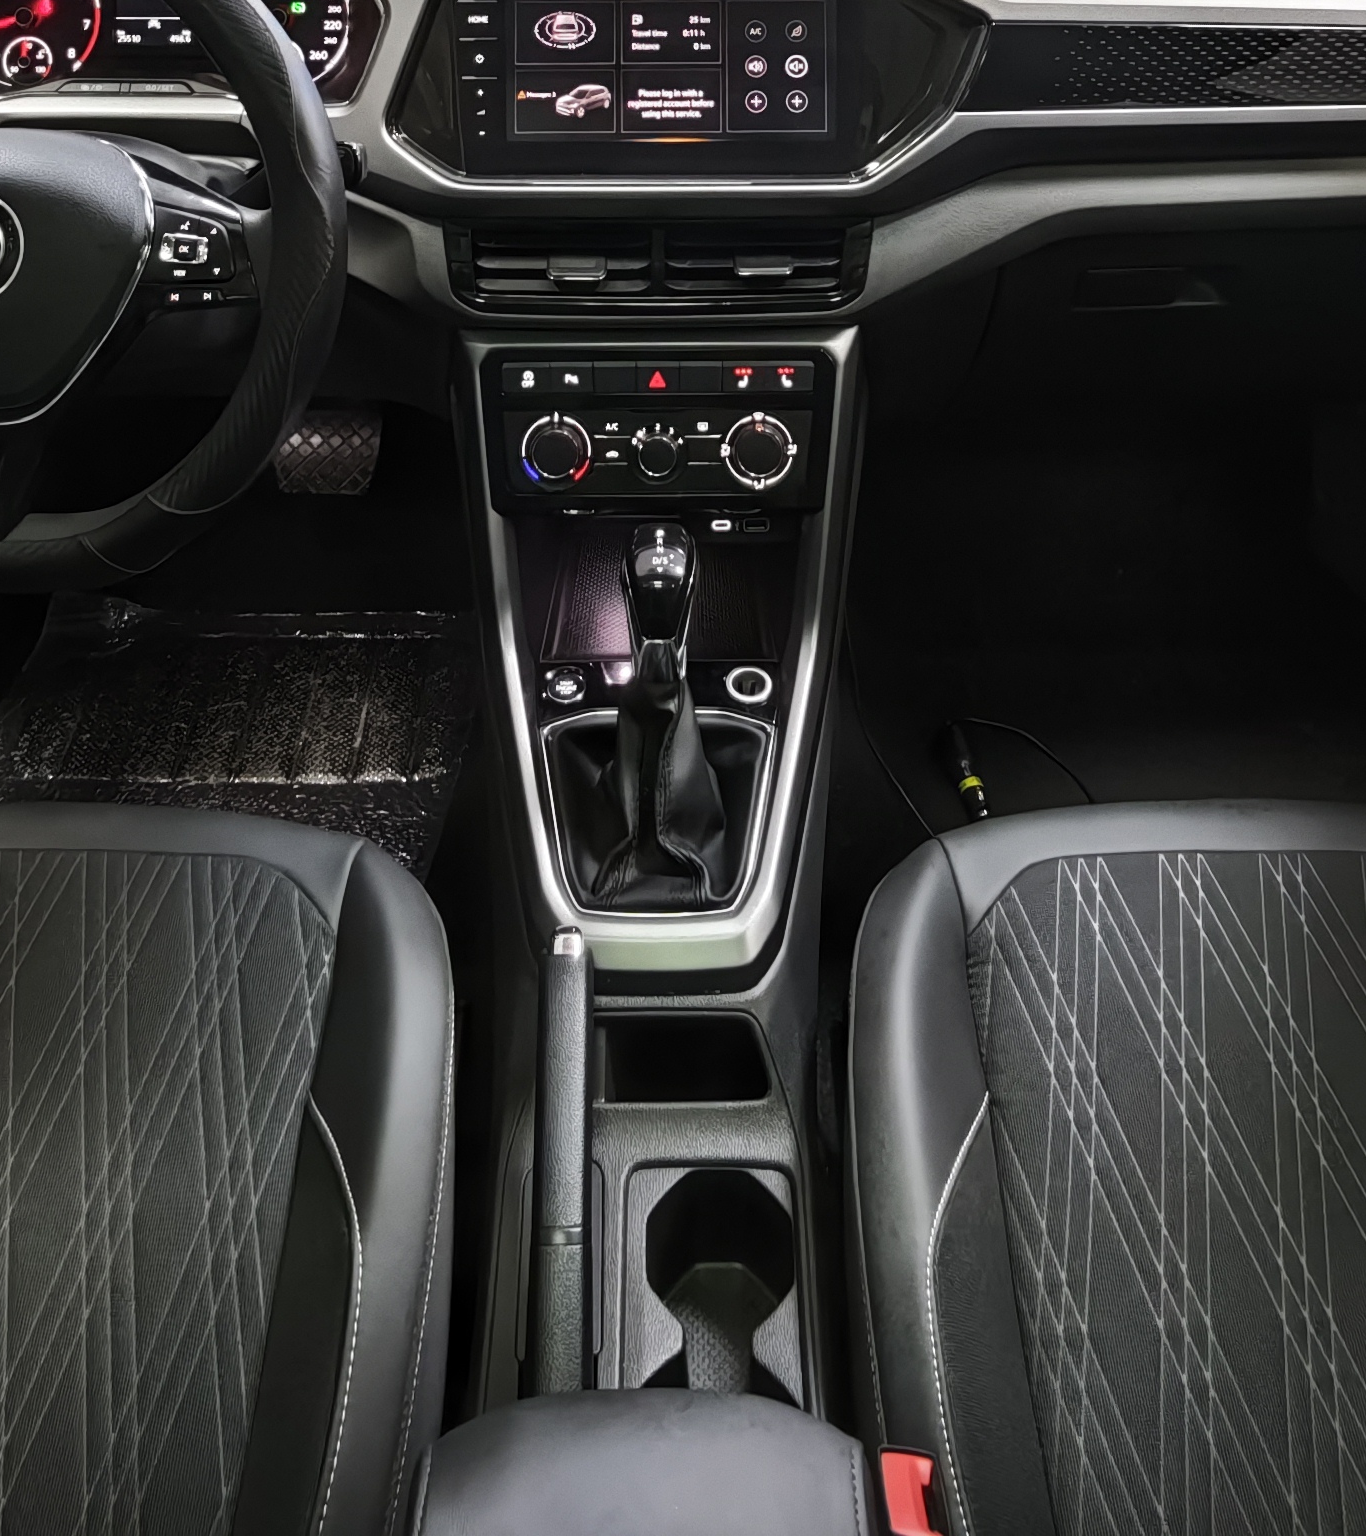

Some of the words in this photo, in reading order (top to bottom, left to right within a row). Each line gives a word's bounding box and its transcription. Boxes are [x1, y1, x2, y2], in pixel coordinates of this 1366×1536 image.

[83, 19, 91, 30] 7
[467, 15, 489, 24] HOME
[324, 20, 342, 30] 220
[67, 48, 76, 59] 8
[309, 50, 328, 60] 260
[178, 245, 189, 253] OK
[605, 422, 619, 431] A/C
